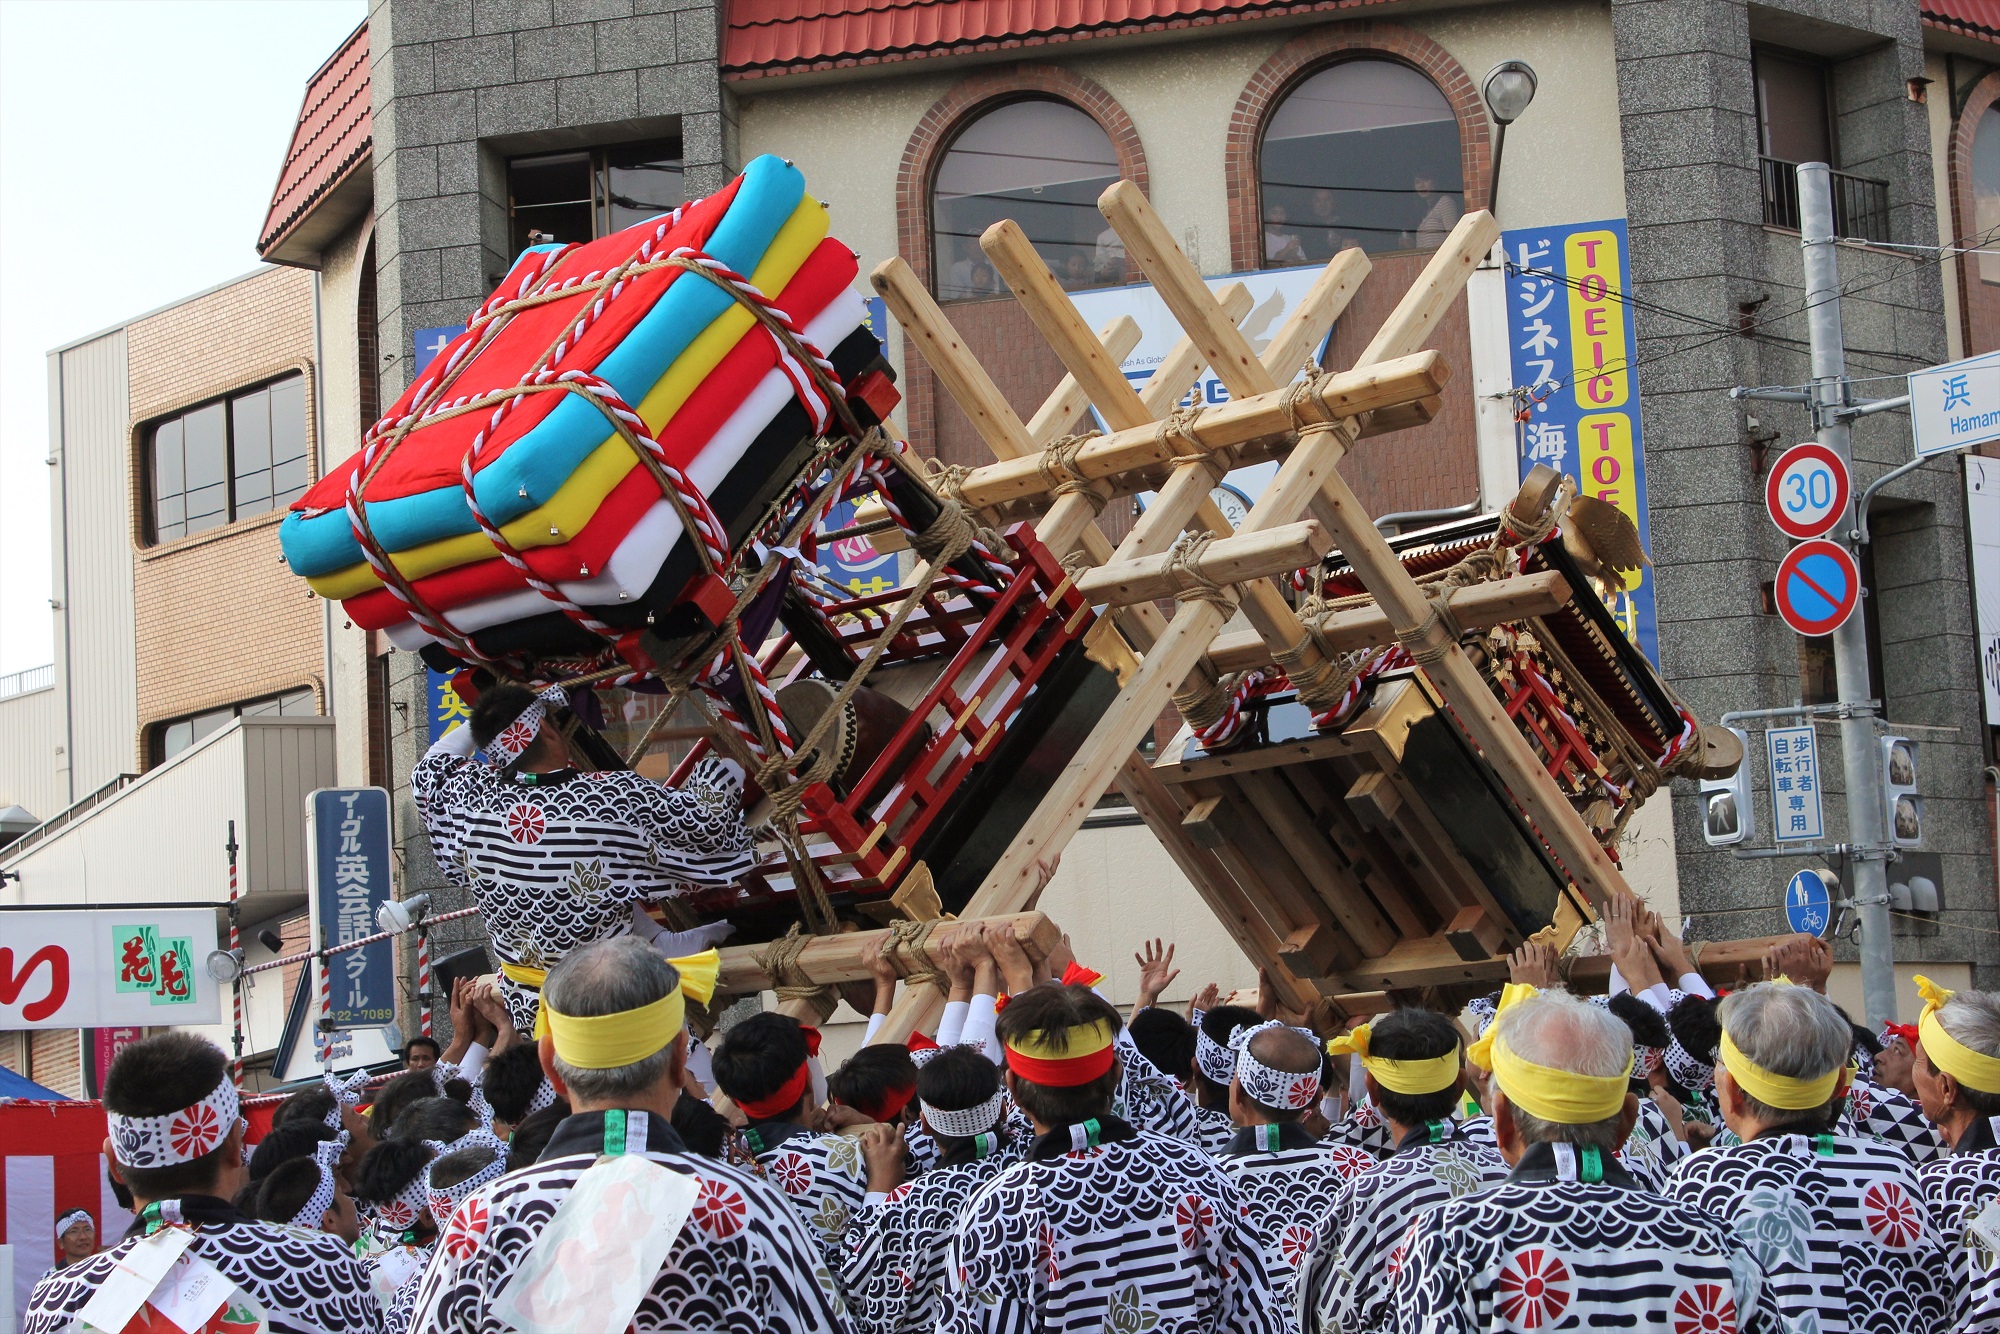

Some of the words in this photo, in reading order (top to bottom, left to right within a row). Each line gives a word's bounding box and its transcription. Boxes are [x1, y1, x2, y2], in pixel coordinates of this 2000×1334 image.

[1577, 240, 1614, 403] TOEIC
[1519, 239, 1568, 478] ビジネス・海
[1942, 374, 1971, 412] 浜
[1786, 469, 1831, 513] 30
[1775, 737, 1793, 792] 自転車
[1793, 735, 1813, 792] 歩行者
[1788, 795, 1807, 832] 専用
[335, 791, 373, 1009] イーグル英会話スクール
[337, 1008, 393, 1021] 22-7089
